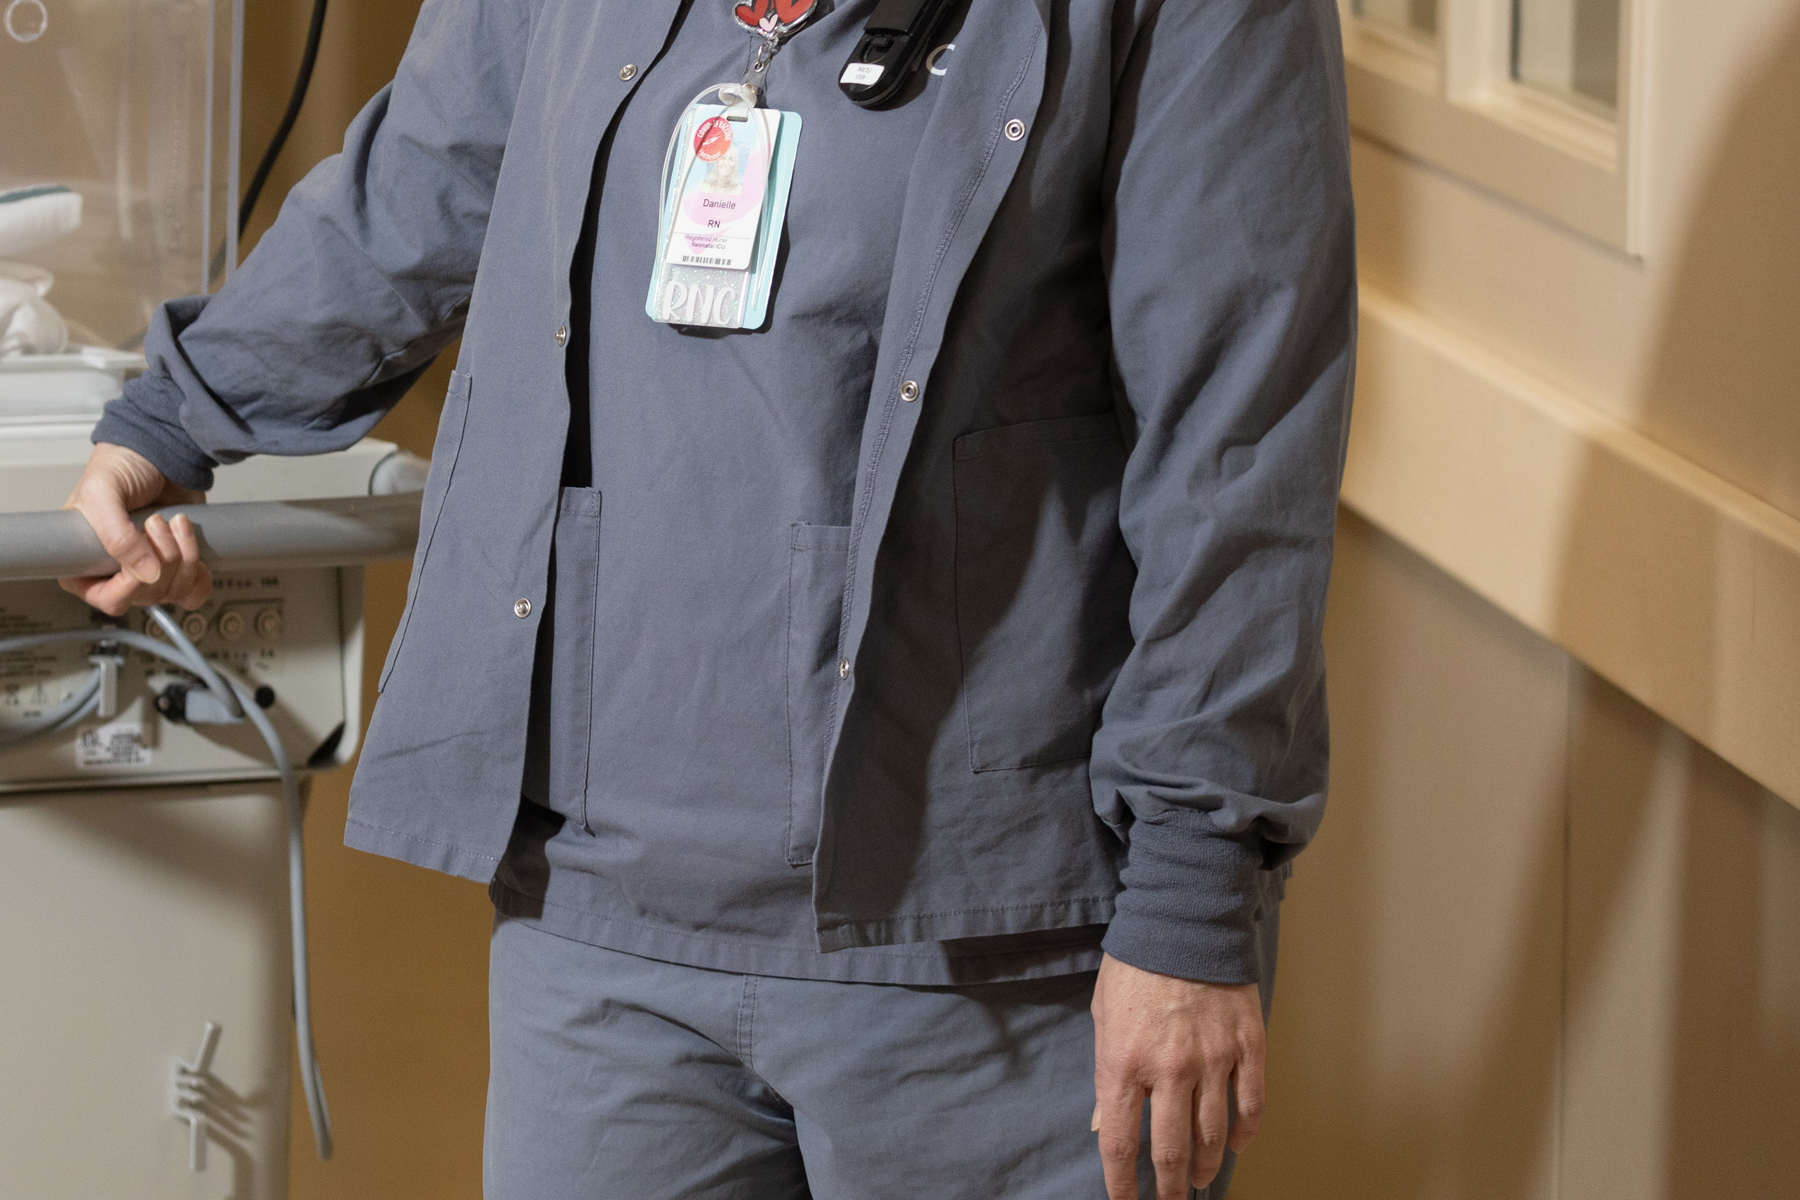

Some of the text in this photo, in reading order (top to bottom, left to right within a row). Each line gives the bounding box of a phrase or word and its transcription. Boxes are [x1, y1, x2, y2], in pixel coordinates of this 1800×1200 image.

[702, 198, 737, 210] Danielle
[707, 219, 721, 229] RN
[685, 233, 712, 243] Registered
[691, 241, 715, 249] Neonatal
[662, 281, 736, 326] RNC
